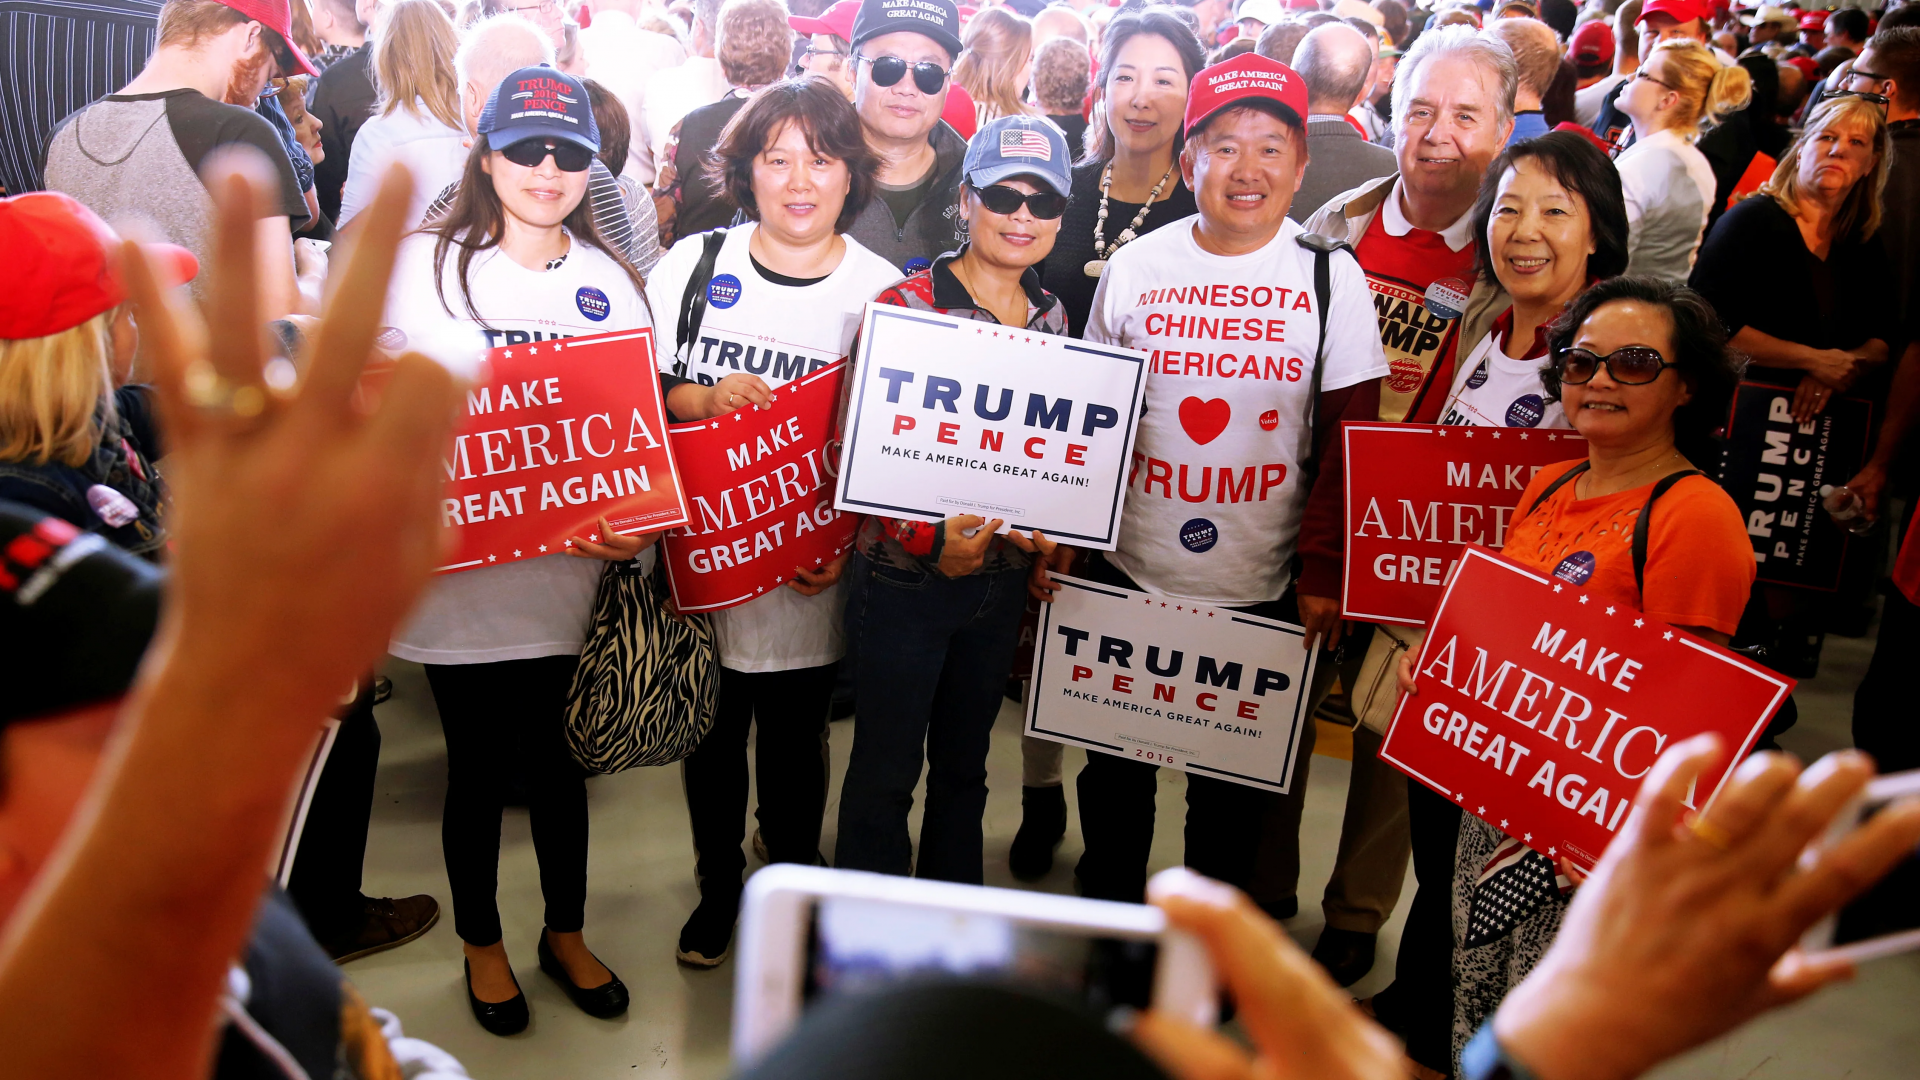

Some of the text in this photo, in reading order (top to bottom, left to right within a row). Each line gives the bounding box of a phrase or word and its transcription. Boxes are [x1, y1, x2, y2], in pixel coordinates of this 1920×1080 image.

[882, 0, 909, 8] MAKE
[910, 0, 948, 18] AMERICA
[887, 10, 944, 26] GREAT AGAIN
[517, 78, 573, 95] TRUMP
[533, 89, 558, 100] 2016
[1208, 70, 1288, 86] MAKE AMERICA
[1214, 80, 1283, 94] GREAT AGAIN
[523, 99, 568, 113] PENCE
[579, 295, 608, 307] TRUMP
[711, 285, 739, 293] TRUMP
[1135, 284, 1312, 314] MINNESOTA
[1388, 287, 1417, 302] FROM
[1435, 286, 1465, 301] TRUMP
[1145, 313, 1286, 343] CHINESE
[1373, 293, 1448, 334] NALD
[1130, 346, 1304, 383] MERICANS
[466, 377, 562, 416] MAKE
[878, 367, 1119, 437] TRUMP
[1513, 402, 1539, 418] TRUMP
[892, 414, 1089, 466] PENCE
[1260, 417, 1277, 425] Voted
[442, 407, 662, 482] MERICA
[726, 416, 804, 471] MAKE
[881, 445, 1090, 488] MAKE AMERICA GREAT AGAIN!
[1129, 451, 1287, 504] TRUMP
[1747, 396, 1795, 563] RUMP
[440, 465, 651, 529] REAT AGAIN
[667, 439, 839, 538] MERIC
[1773, 418, 1816, 559] PENCE
[1796, 416, 1833, 566] MAKE AMERICA GREAT AGAIN!
[688, 520, 785, 574] GREAT
[1183, 527, 1213, 540] TRUMP
[1561, 560, 1589, 575] TRUMP
[1057, 624, 1291, 697] TRUMP
[1531, 621, 1643, 692] MAKE
[1071, 664, 1260, 721] PENCE
[1063, 688, 1263, 739] MAKE AMERICA GREAT AGAIN!
[1422, 635, 1698, 810] AMERIC
[1136, 749, 1174, 764] 2016
[1423, 702, 1629, 832] GREAT AGAI
